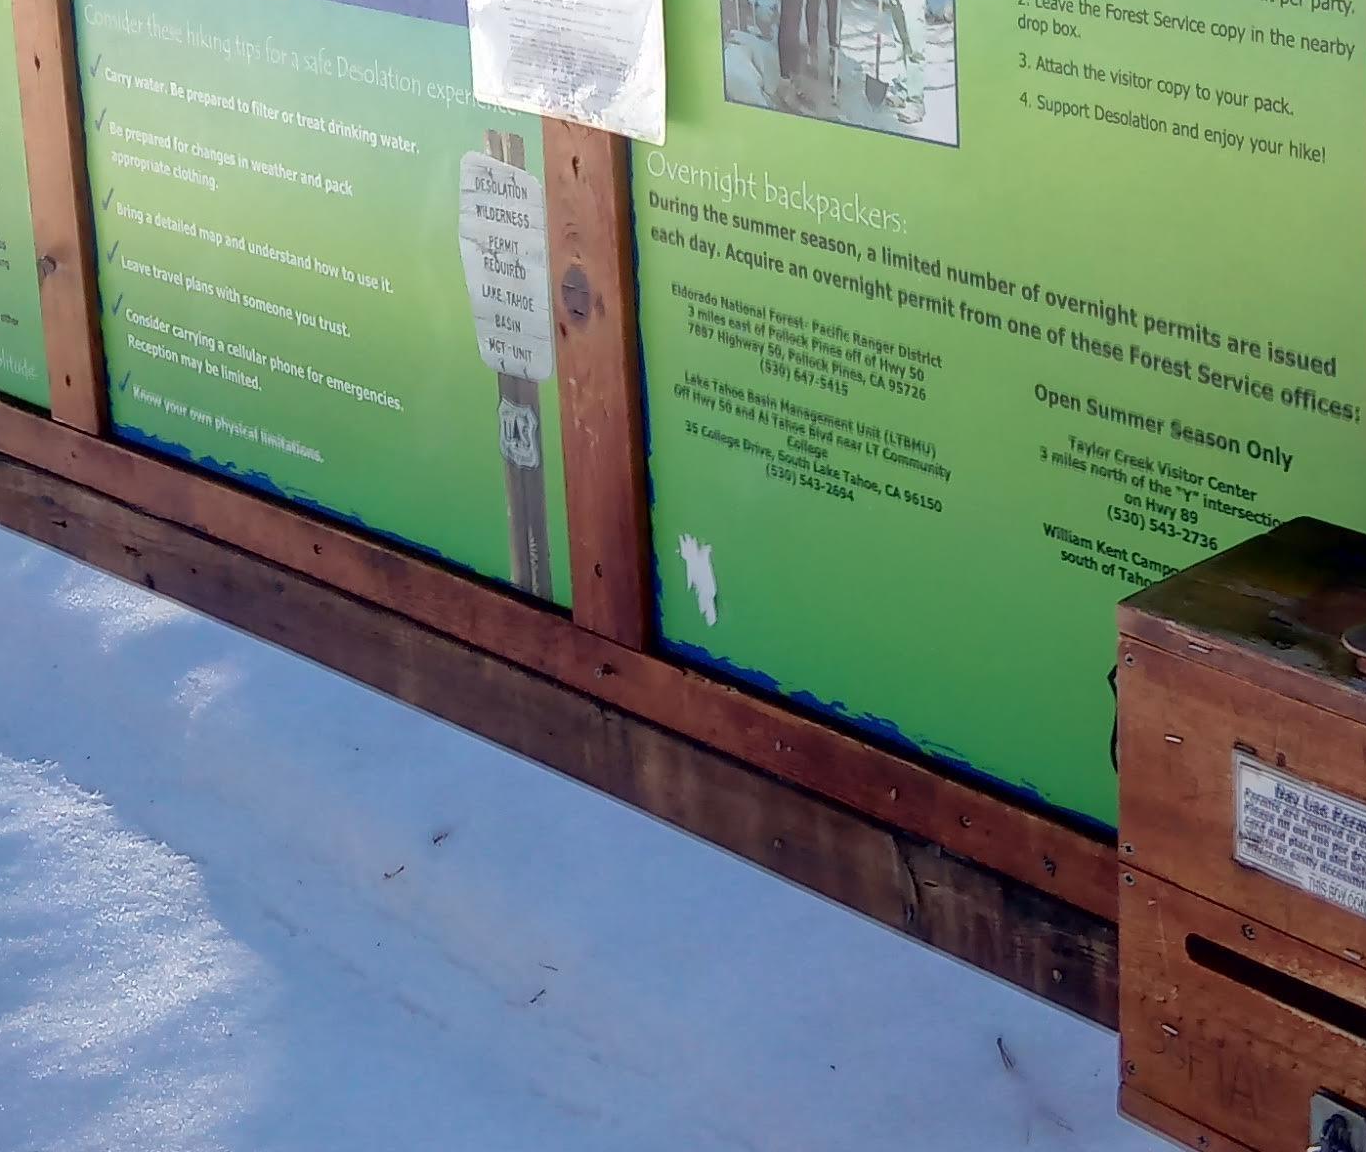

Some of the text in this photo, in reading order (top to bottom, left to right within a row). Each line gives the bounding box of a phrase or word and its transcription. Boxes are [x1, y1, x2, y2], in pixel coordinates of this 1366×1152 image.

[105, 66, 419, 157] Carry water. Be prepared to filter or treat drinking water.
[1019, 91, 1325, 165] 4. Support Desolation and enjoy your hike!
[476, 177, 528, 200] DESOLATION
[476, 204, 530, 229] WILDERNESS
[647, 150, 907, 234] Overnight backpackers:
[488, 236, 520, 255] PERMIT
[495, 313, 521, 333] BASIN
[1035, 384, 1294, 473] Open Summer Season Only
[1069, 435, 1259, 501] Taylor Creek Visitor Center
[1107, 505, 1219, 551] (530) 543-2736
